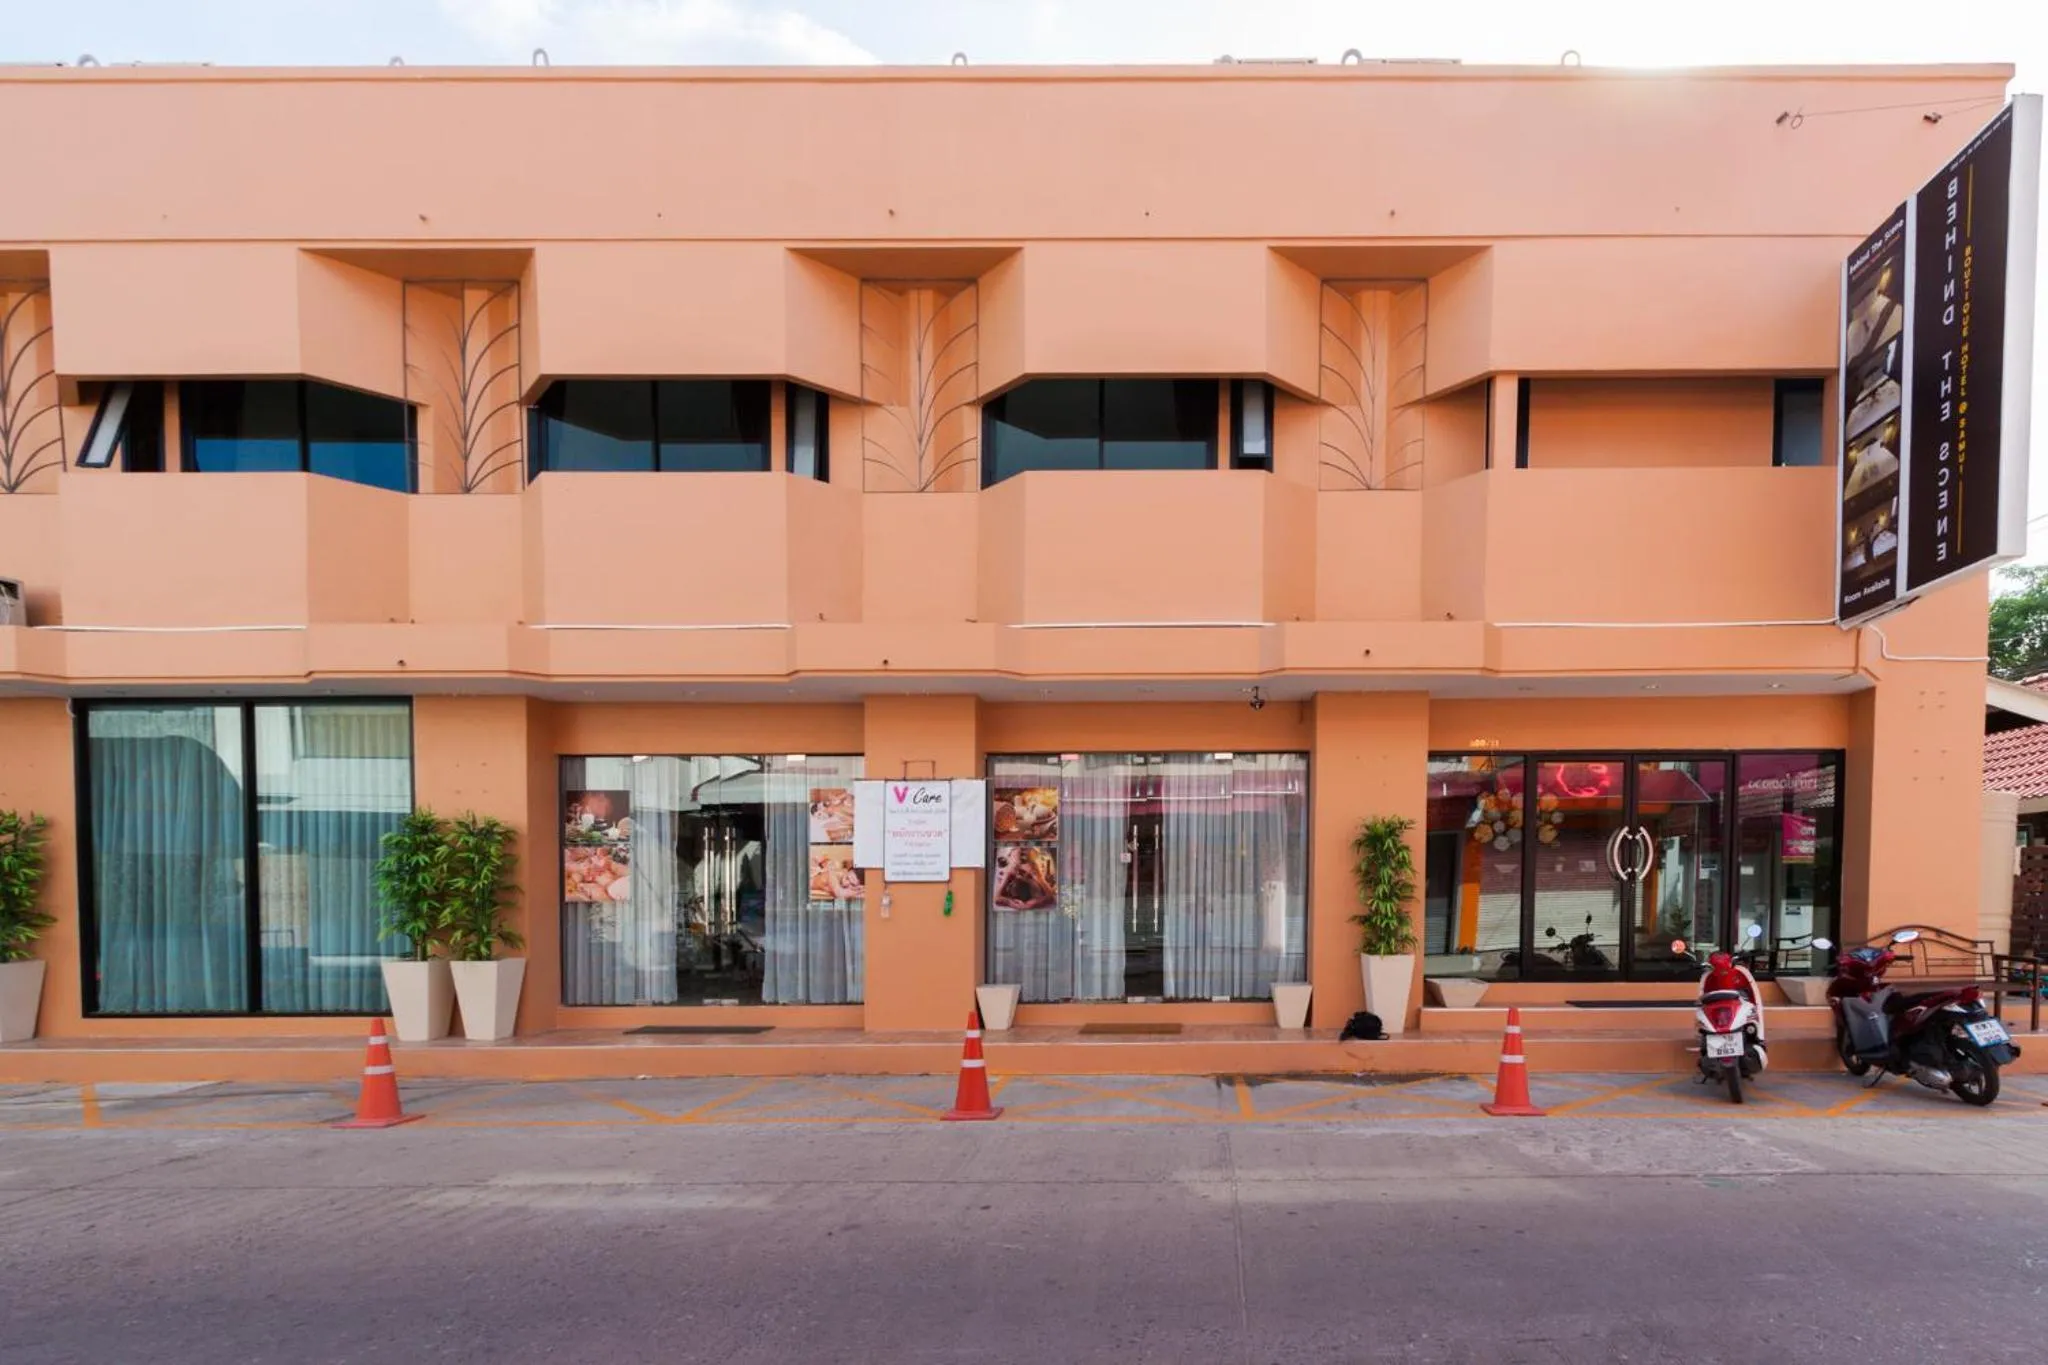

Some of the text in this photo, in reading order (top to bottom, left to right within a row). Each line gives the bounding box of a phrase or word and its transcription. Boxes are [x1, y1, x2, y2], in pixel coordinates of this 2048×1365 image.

[1962, 245, 1972, 337] BOUTIQUE
[1960, 342, 1969, 397] HOTEL
[1957, 417, 1967, 474] SAMUI
[912, 787, 942, 805] Care
